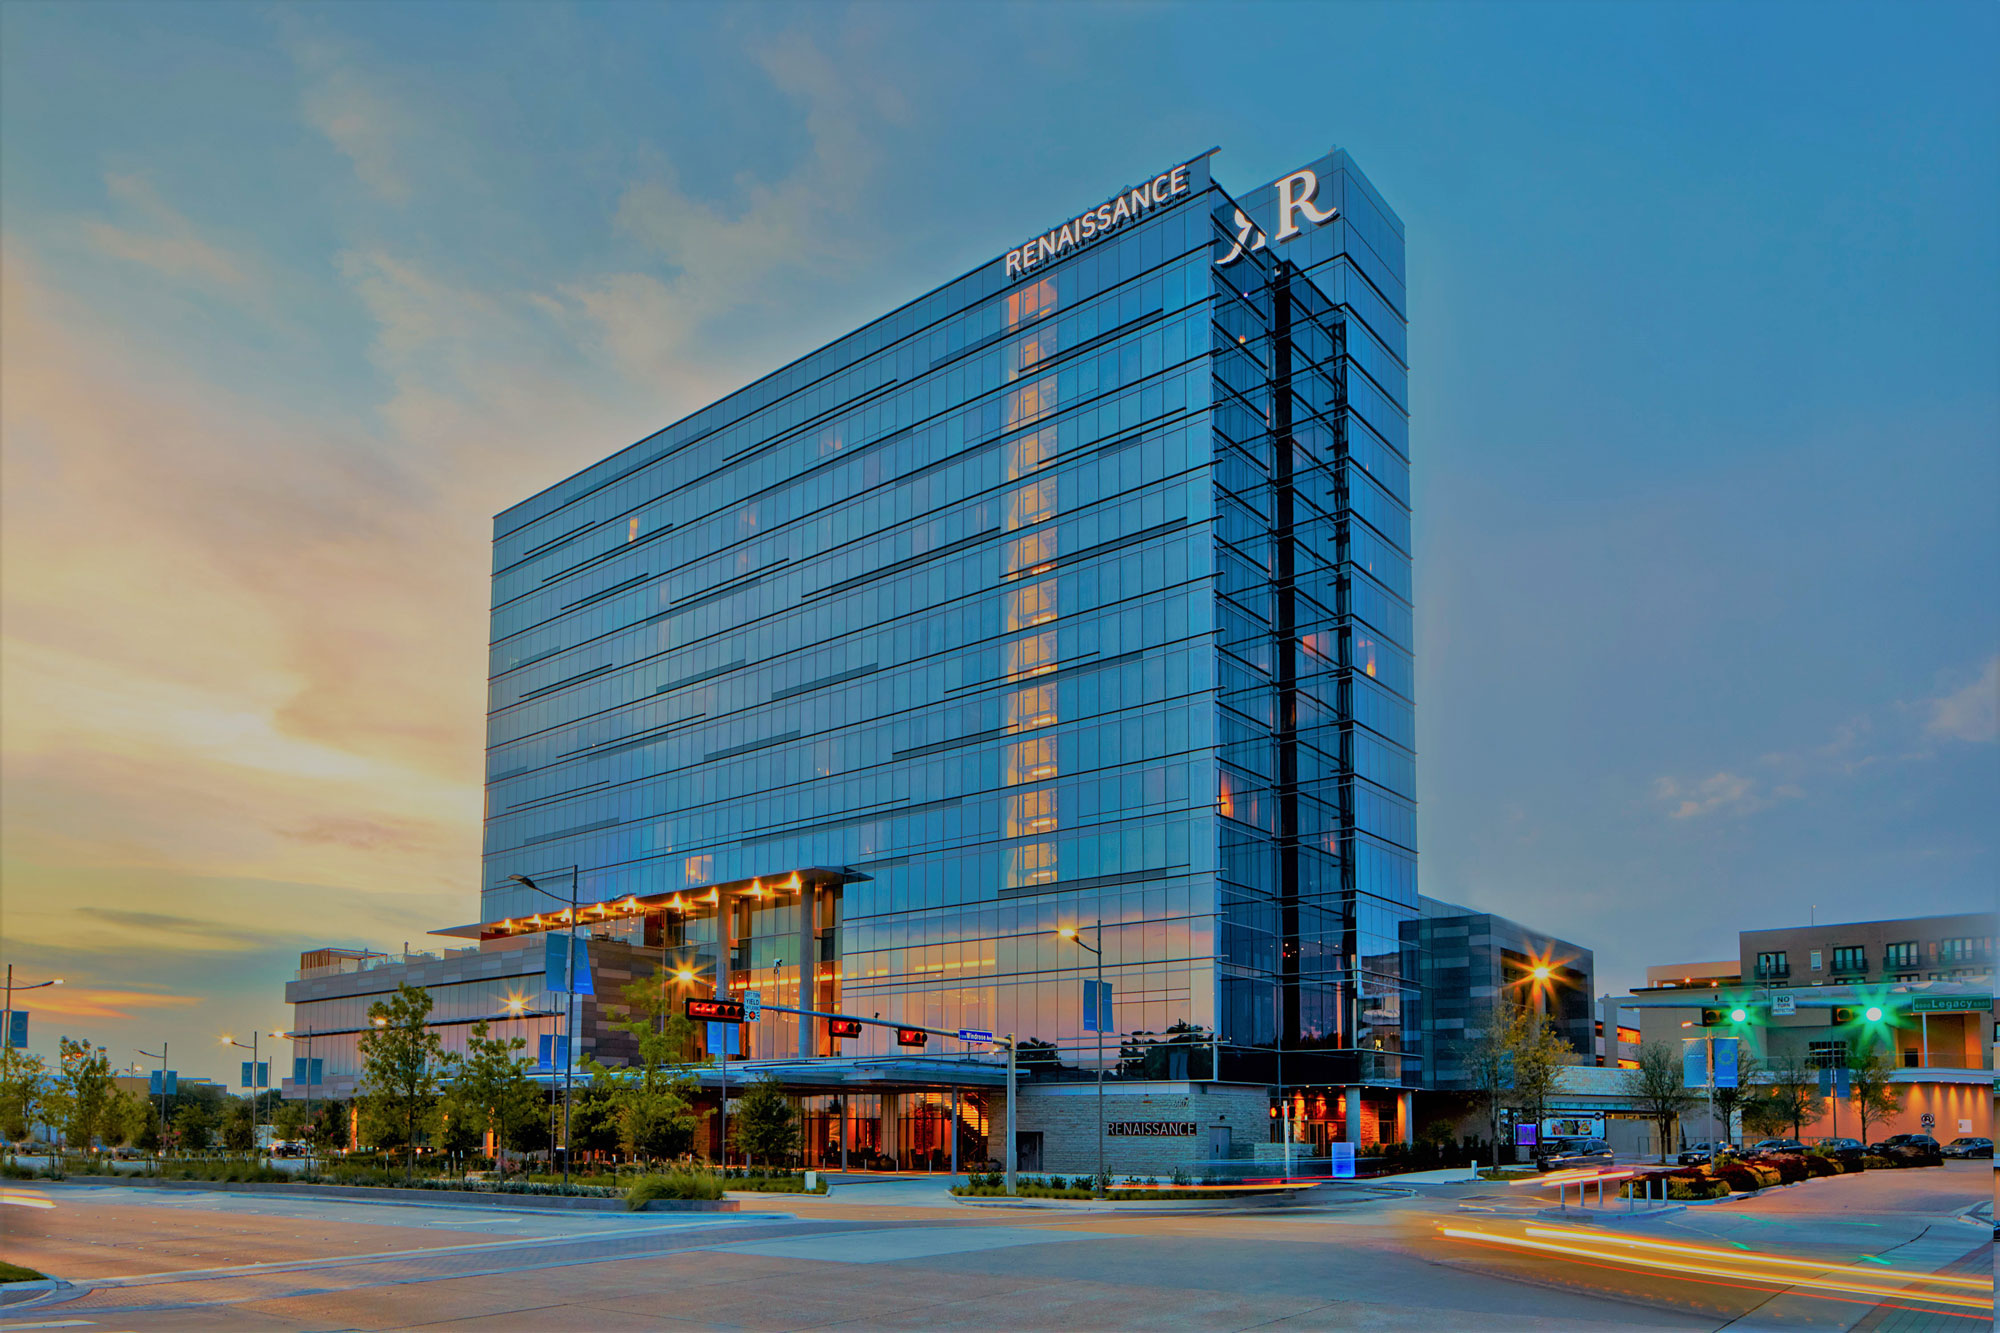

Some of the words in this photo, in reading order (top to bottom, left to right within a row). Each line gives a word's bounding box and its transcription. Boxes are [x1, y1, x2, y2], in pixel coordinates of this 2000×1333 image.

[1006, 165, 1187, 276] RENAISSANCE
[1274, 170, 1337, 240] R
[1931, 1000, 1973, 1010] Legacy
[1107, 1122, 1197, 1136] RENAISSANCE
